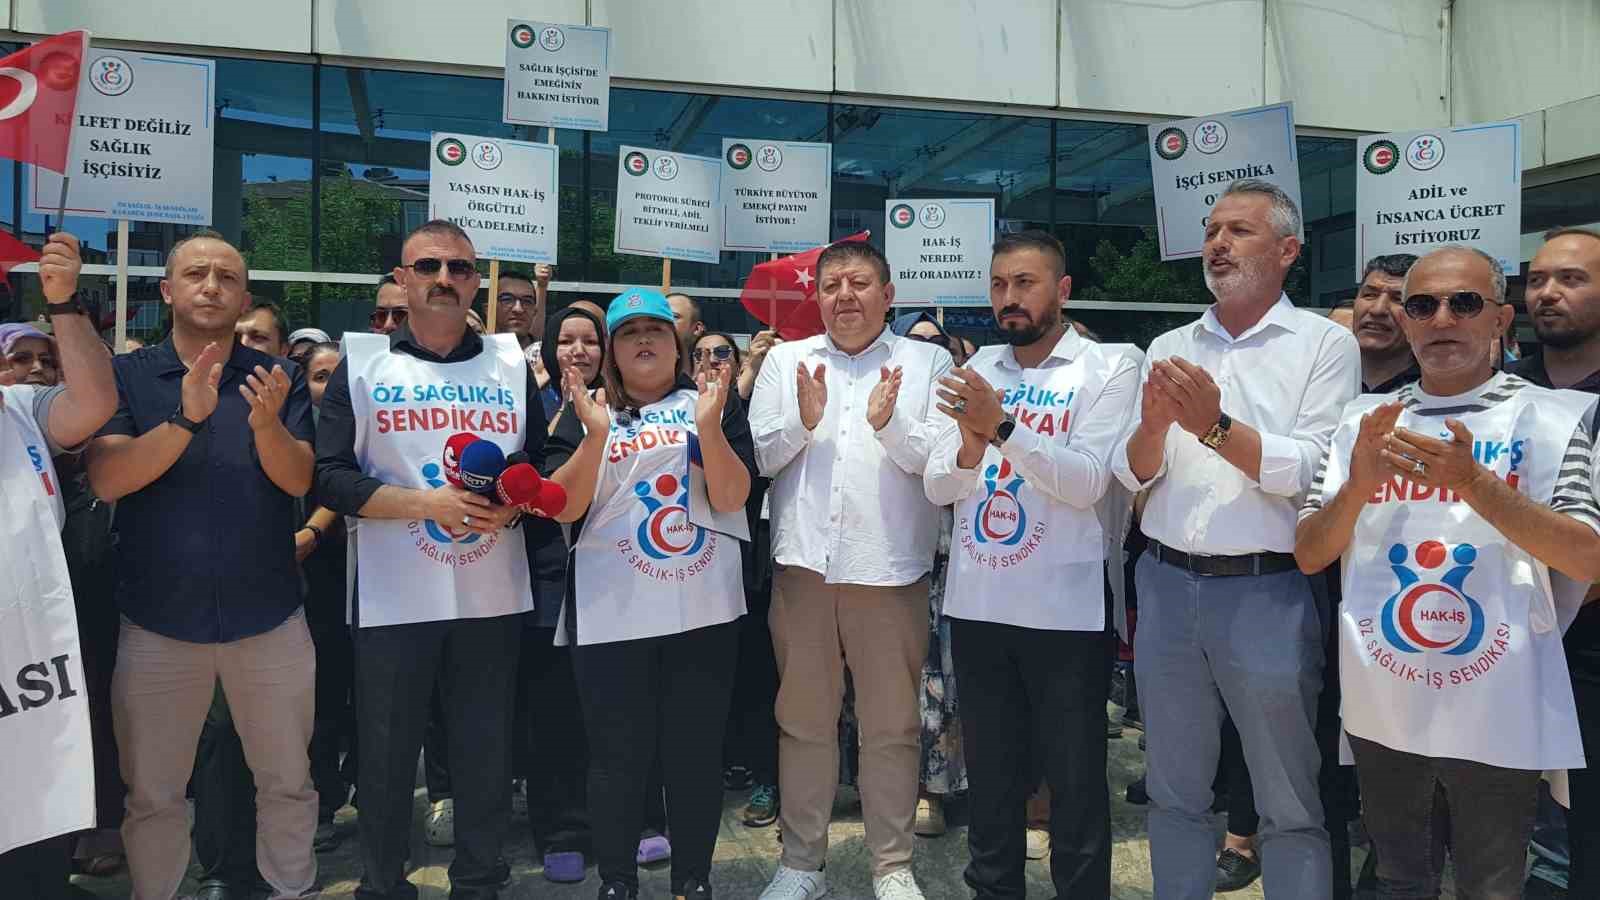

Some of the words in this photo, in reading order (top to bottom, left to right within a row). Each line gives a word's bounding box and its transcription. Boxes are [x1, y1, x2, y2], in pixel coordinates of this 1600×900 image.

[519, 63, 555, 74] SAĞLIK
[534, 78, 583, 90] EMEĞİNİN
[517, 91, 560, 103] HAKKINI
[561, 93, 600, 106] İSTİYOR
[55, 113, 121, 130] KLFET
[124, 118, 192, 136] DEĞİLİZ
[89, 138, 152, 156] SAĞLIK
[82, 159, 162, 180] İŞÇİSİYİZ
[1175, 171, 1205, 191] İŞÇİ
[1207, 161, 1275, 184] SENDİKA
[448, 182, 500, 196] YAŞASIN
[503, 187, 545, 203] HAK-İŞ
[634, 191, 679, 206] PROTOKOL
[734, 186, 774, 198] TÜRKİYE
[1408, 184, 1447, 201] ADİL
[1449, 187, 1468, 197] ve
[467, 200, 527, 216] ÖRGÜTLÜ
[742, 200, 777, 213] EMEKÇİ
[778, 204, 808, 213] PAYINI
[1376, 209, 1445, 225] İNSANCA
[1450, 204, 1506, 220] ÜCRET
[663, 219, 709, 233] VERİLMELİ
[755, 214, 791, 225] İSTİYOR
[922, 236, 961, 249] HAK-İŞ
[1394, 228, 1481, 246] İSTİYORUZ
[919, 254, 964, 264] NEREDE
[899, 268, 918, 280] BİZ
[919, 270, 976, 280] ORADAYIZ
[373, 381, 406, 403] ÖZ
[413, 380, 514, 411] SAĞLIK-İŞ
[376, 404, 518, 434] SENDİKASI
[989, 510, 1017, 522] HAK-İŞ
[666, 523, 693, 535] HAK-İŞ
[1000, 521, 1047, 568] SENDİKASI
[628, 555, 686, 582] SAĞLIK-İŞ
[1420, 608, 1466, 625] HAK-İŞ
[1367, 640, 1443, 690] SAĞLIK-İŞ
[1449, 622, 1511, 685] SENDİKASI
